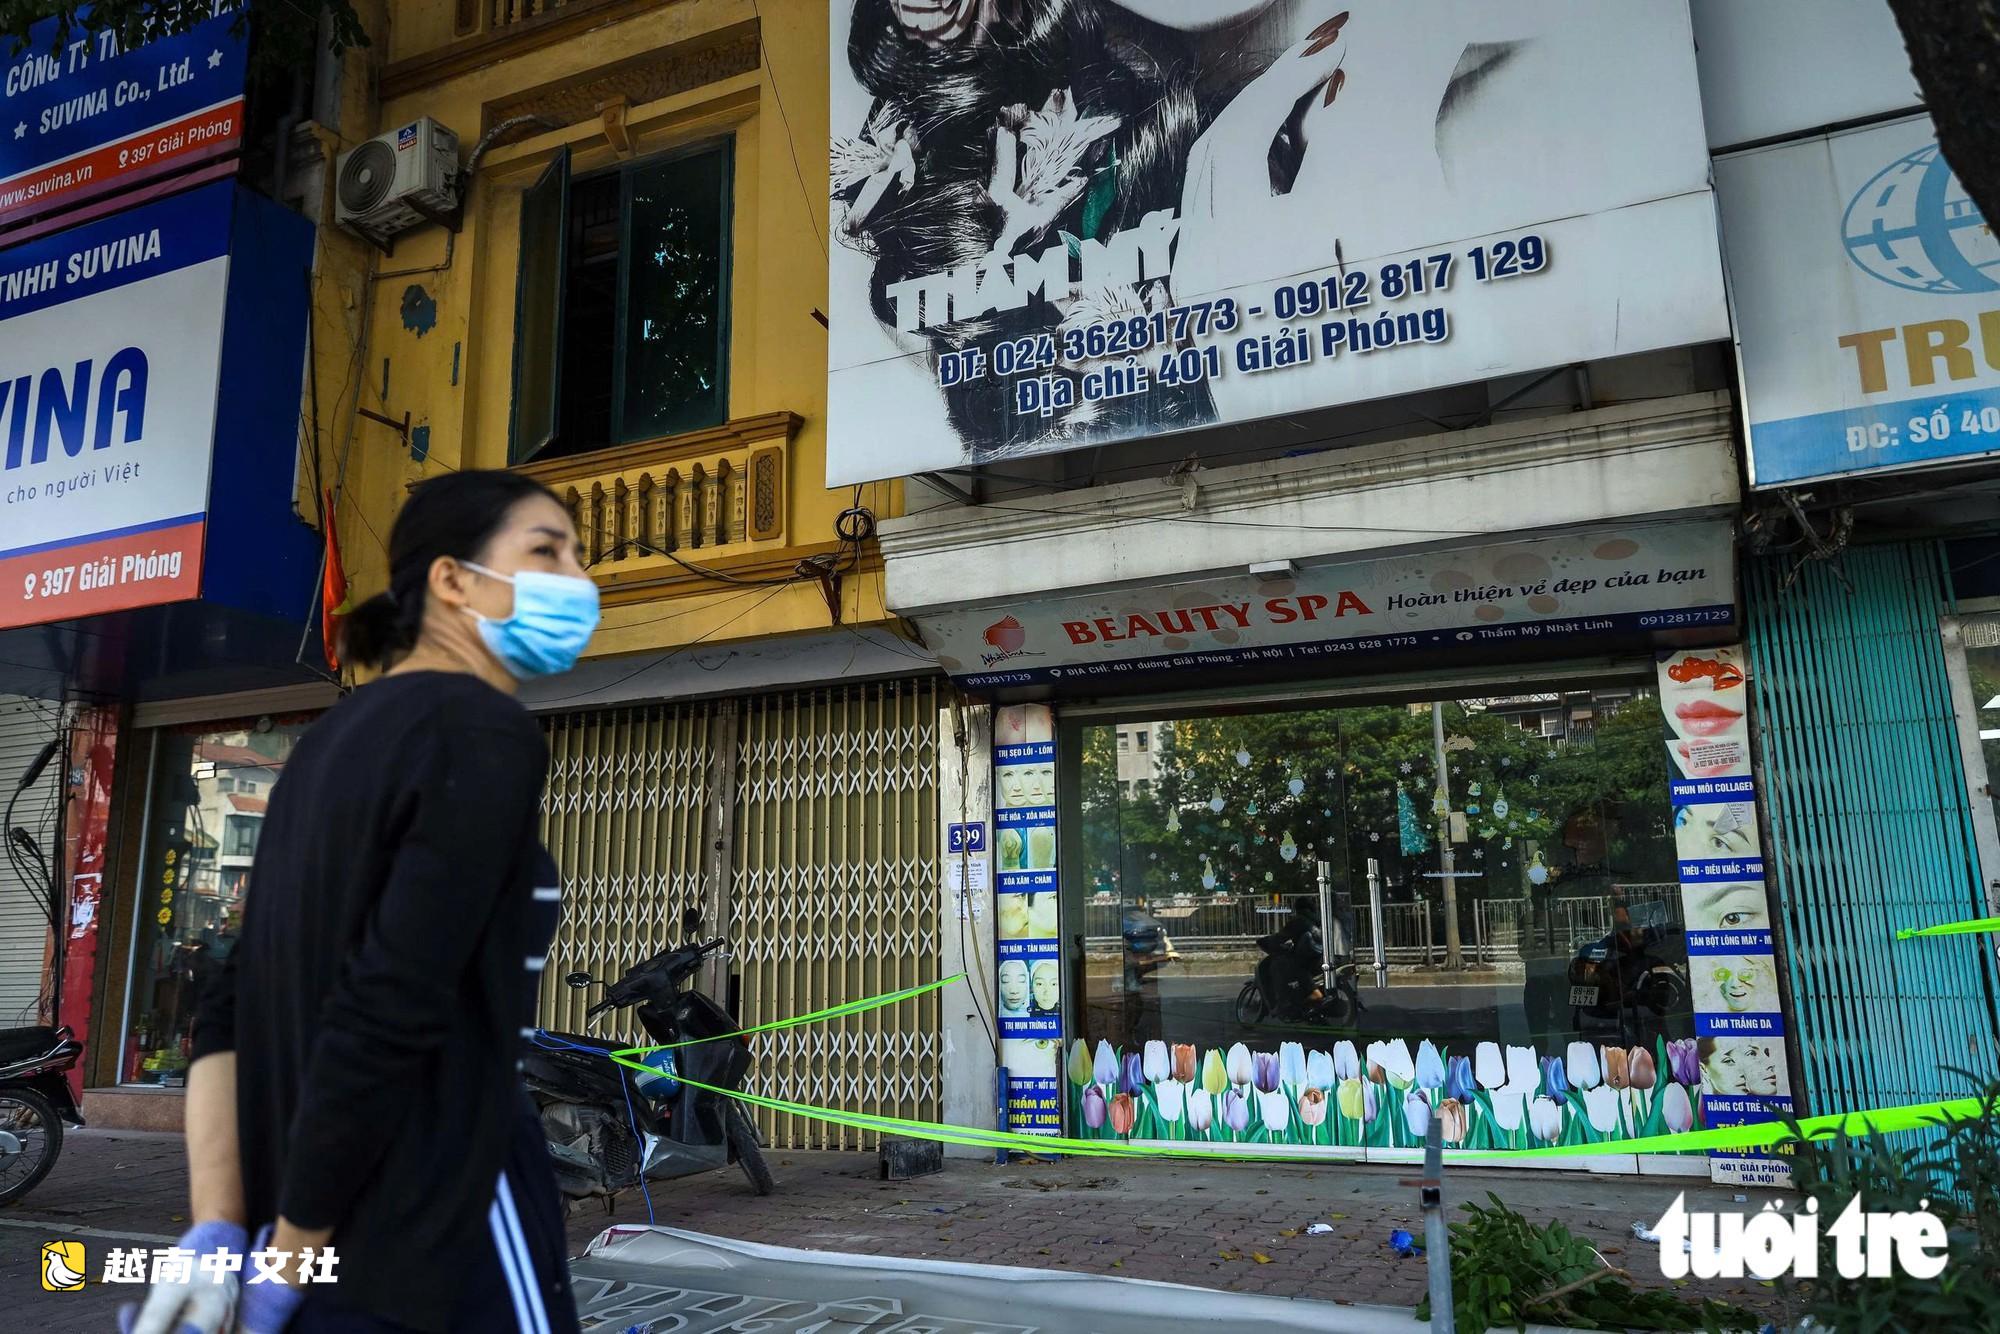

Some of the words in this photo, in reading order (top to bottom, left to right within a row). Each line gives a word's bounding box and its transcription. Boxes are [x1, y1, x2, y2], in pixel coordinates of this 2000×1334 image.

[6, 53, 61, 97] CÔNG
[39, 88, 108, 135] SUVINA
[114, 80, 151, 106] Co.,
[158, 57, 195, 92] Ltd.
[131, 143, 153, 165] 397
[157, 132, 184, 155] Giải
[188, 118, 232, 143] Phóng
[66, 228, 161, 284] SUVINA
[939, 349, 985, 387] ĐT:
[994, 338, 1055, 377] 024
[1064, 297, 1237, 359] 36281773
[1273, 275, 1369, 320] 0912
[1380, 252, 1453, 301] 817
[1469, 235, 1545, 283] 129
[1016, 377, 1073, 417] Địa
[1085, 357, 1148, 401] chỉ:
[1158, 345, 1220, 387] 401
[1236, 327, 1308, 373] Giải
[1320, 306, 1448, 358] Phóng
[1846, 422, 1899, 452] ĐC:
[1908, 403, 1950, 443] SỐ
[7, 486, 37, 504] cho
[45, 470, 96, 499] người
[104, 462, 141, 484] Việt
[40, 567, 75, 597] 397
[80, 556, 115, 591] Giải
[121, 550, 182, 584] Phóng
[1387, 589, 1447, 610] Hoàn
[1454, 583, 1513, 604] thiện
[1520, 578, 1547, 595] vẻ
[1553, 574, 1596, 595] đẹp
[1605, 567, 1649, 588] của
[1657, 566, 1705, 583] bạn
[1062, 602, 1254, 645] BEAUTY
[1264, 590, 1374, 625] SPA
[1521, 625, 1541, 638] Mỹ
[1547, 622, 1579, 634] Nhật
[1584, 619, 1613, 631] Linh
[1639, 610, 1730, 626] 0912817129
[967, 672, 1032, 686] 0912817129
[1113, 662, 1133, 672] 401
[1173, 654, 1194, 666] Giải
[1199, 652, 1233, 664] Phóng
[1263, 648, 1283, 659] NỘI
[1299, 645, 1321, 656] Tel:
[1324, 642, 1355, 653] 0243
[1359, 639, 1382, 649] 628
[1387, 636, 1417, 647] 1773
[1673, 785, 1696, 796] PHUN
[1697, 782, 1713, 794] MÔI
[1721, 934, 1740, 946] LÔNG
[1710, 1017, 1729, 1029] LÀM
[1730, 1015, 1758, 1029] TRẮNG
[1760, 1019, 1772, 1029] DA
[1035, 1114, 1060, 1125] LINH
[1707, 1099, 1731, 1112] NÂNG
[1733, 1101, 1744, 1112] CƠ
[1720, 1163, 1736, 1172] 401
[1742, 1172, 1755, 1182] HÀ
[1757, 1172, 1775, 1184] NỘI
